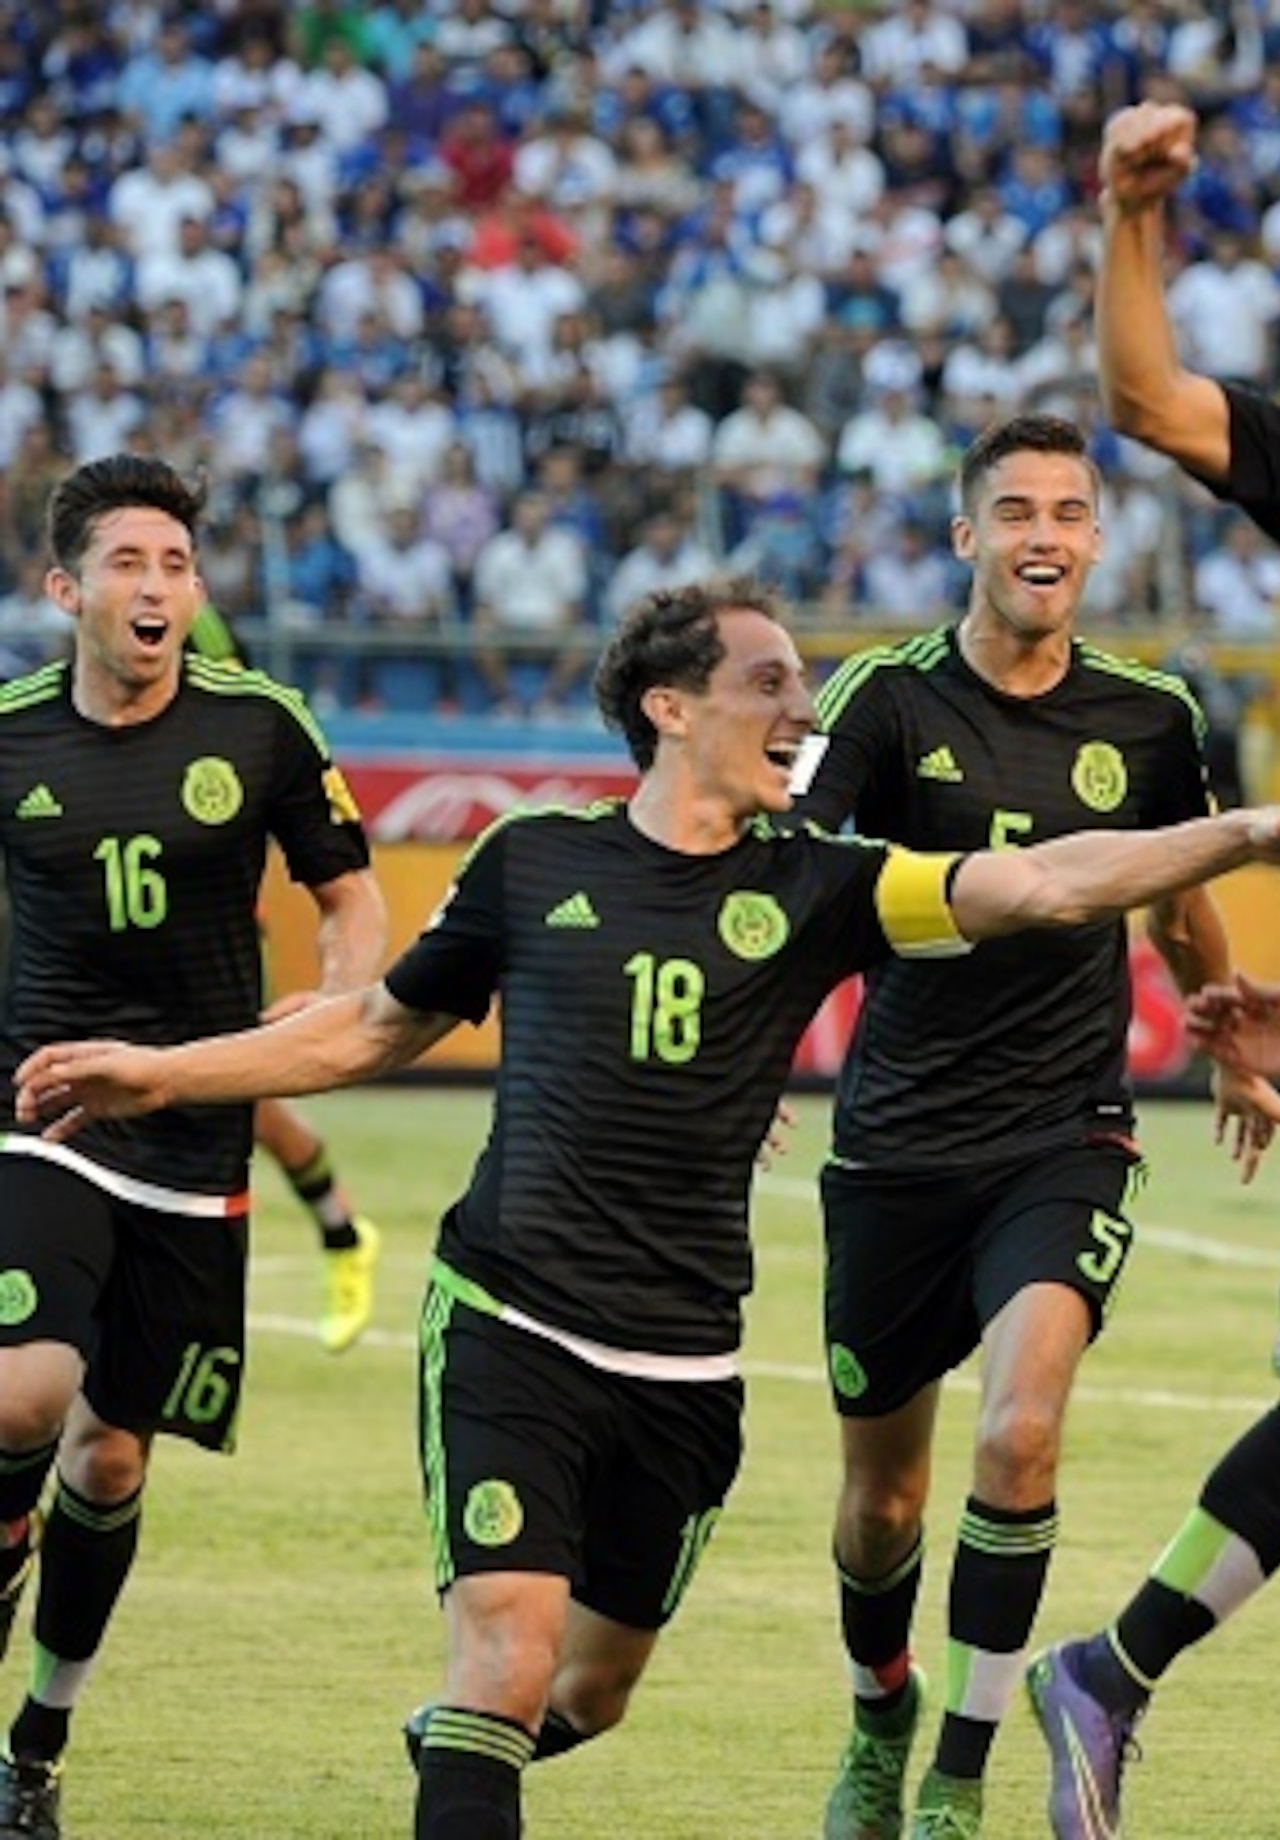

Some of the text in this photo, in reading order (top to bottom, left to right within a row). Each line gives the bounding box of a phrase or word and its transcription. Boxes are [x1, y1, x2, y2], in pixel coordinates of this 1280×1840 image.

[95, 834, 166, 931] 16
[625, 951, 704, 1063] 18
[1077, 1209, 1129, 1281] 5
[162, 1342, 239, 1423] 16
